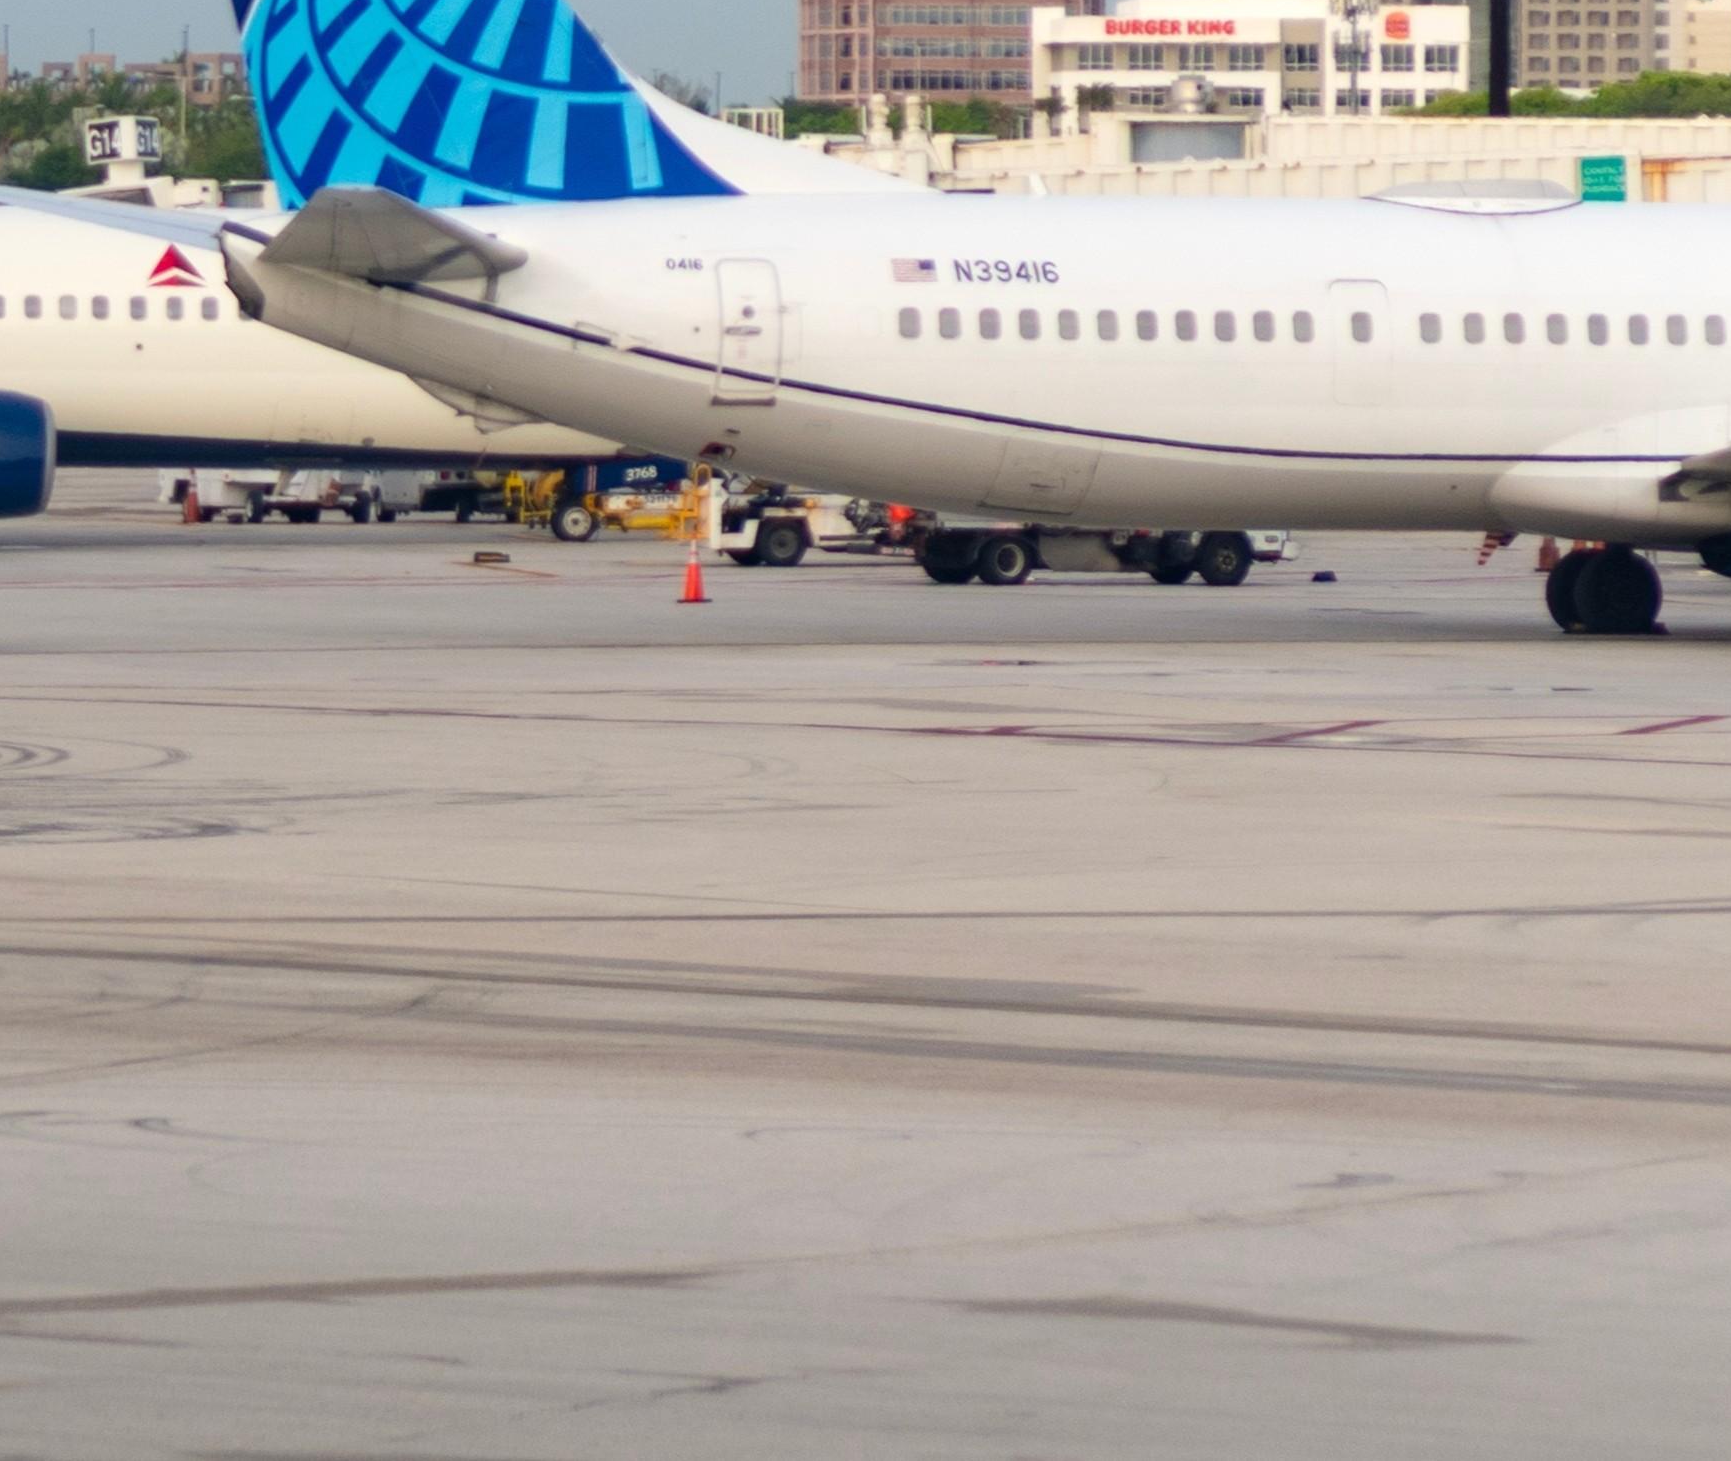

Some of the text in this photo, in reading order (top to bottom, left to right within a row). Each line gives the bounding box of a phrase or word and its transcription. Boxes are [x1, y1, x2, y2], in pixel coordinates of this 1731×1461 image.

[1105, 20, 1235, 35] BURGER KING
[90, 128, 120, 156] G14
[138, 125, 159, 153] G14
[665, 258, 704, 271] 0416
[953, 258, 1059, 284] N39416
[625, 465, 658, 482] 3768
